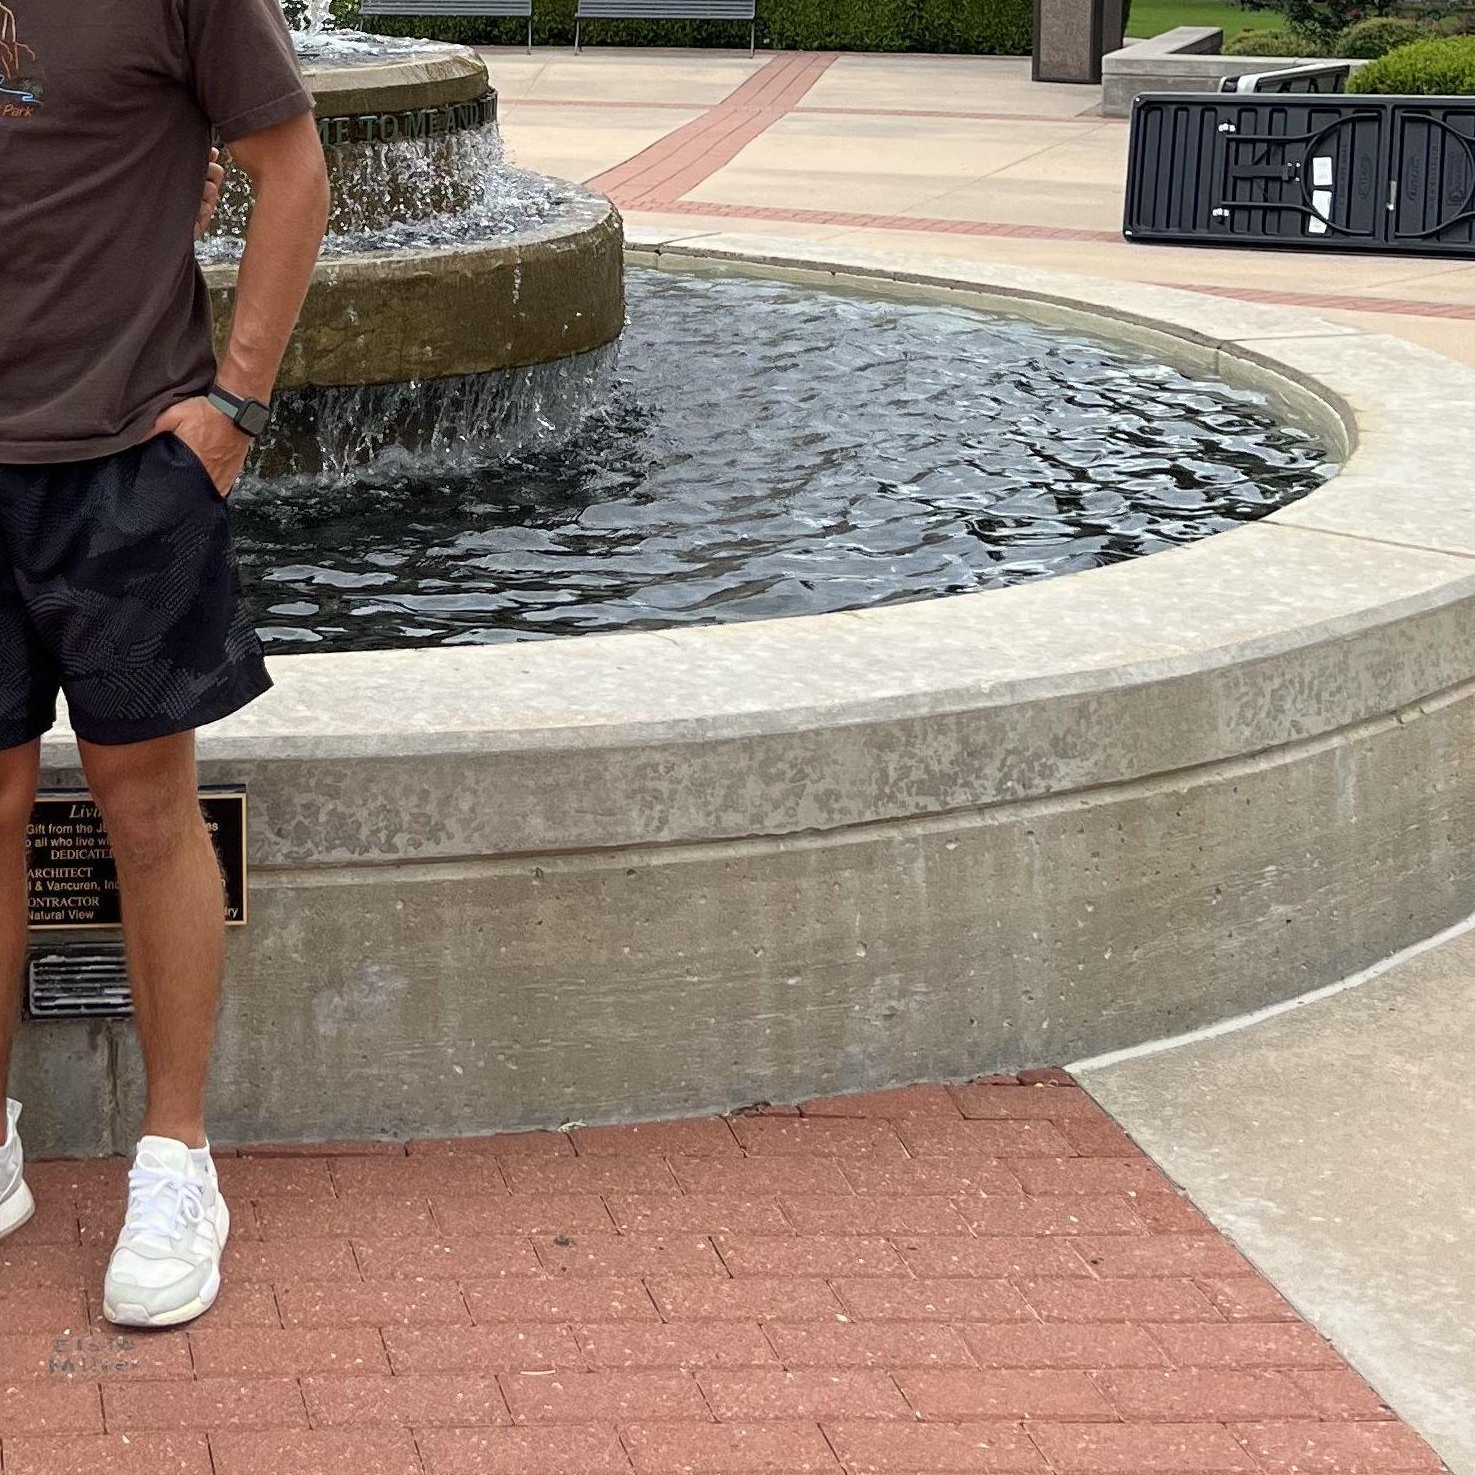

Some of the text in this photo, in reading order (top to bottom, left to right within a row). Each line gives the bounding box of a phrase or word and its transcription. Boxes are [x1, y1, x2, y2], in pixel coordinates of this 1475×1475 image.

[3, 103, 34, 117] Park
[359, 115, 399, 143] TO
[405, 109, 438, 138] ME
[27, 823, 46, 835] Gift
[48, 823, 73, 834] from
[76, 823, 94, 834] the
[34, 837, 47, 848] all
[51, 837, 73, 847] who
[76, 837, 95, 847] live
[27, 867, 93, 878] ARCHITECT
[27, 897, 100, 908] ONTRACTOR
[68, 909, 94, 920] View
